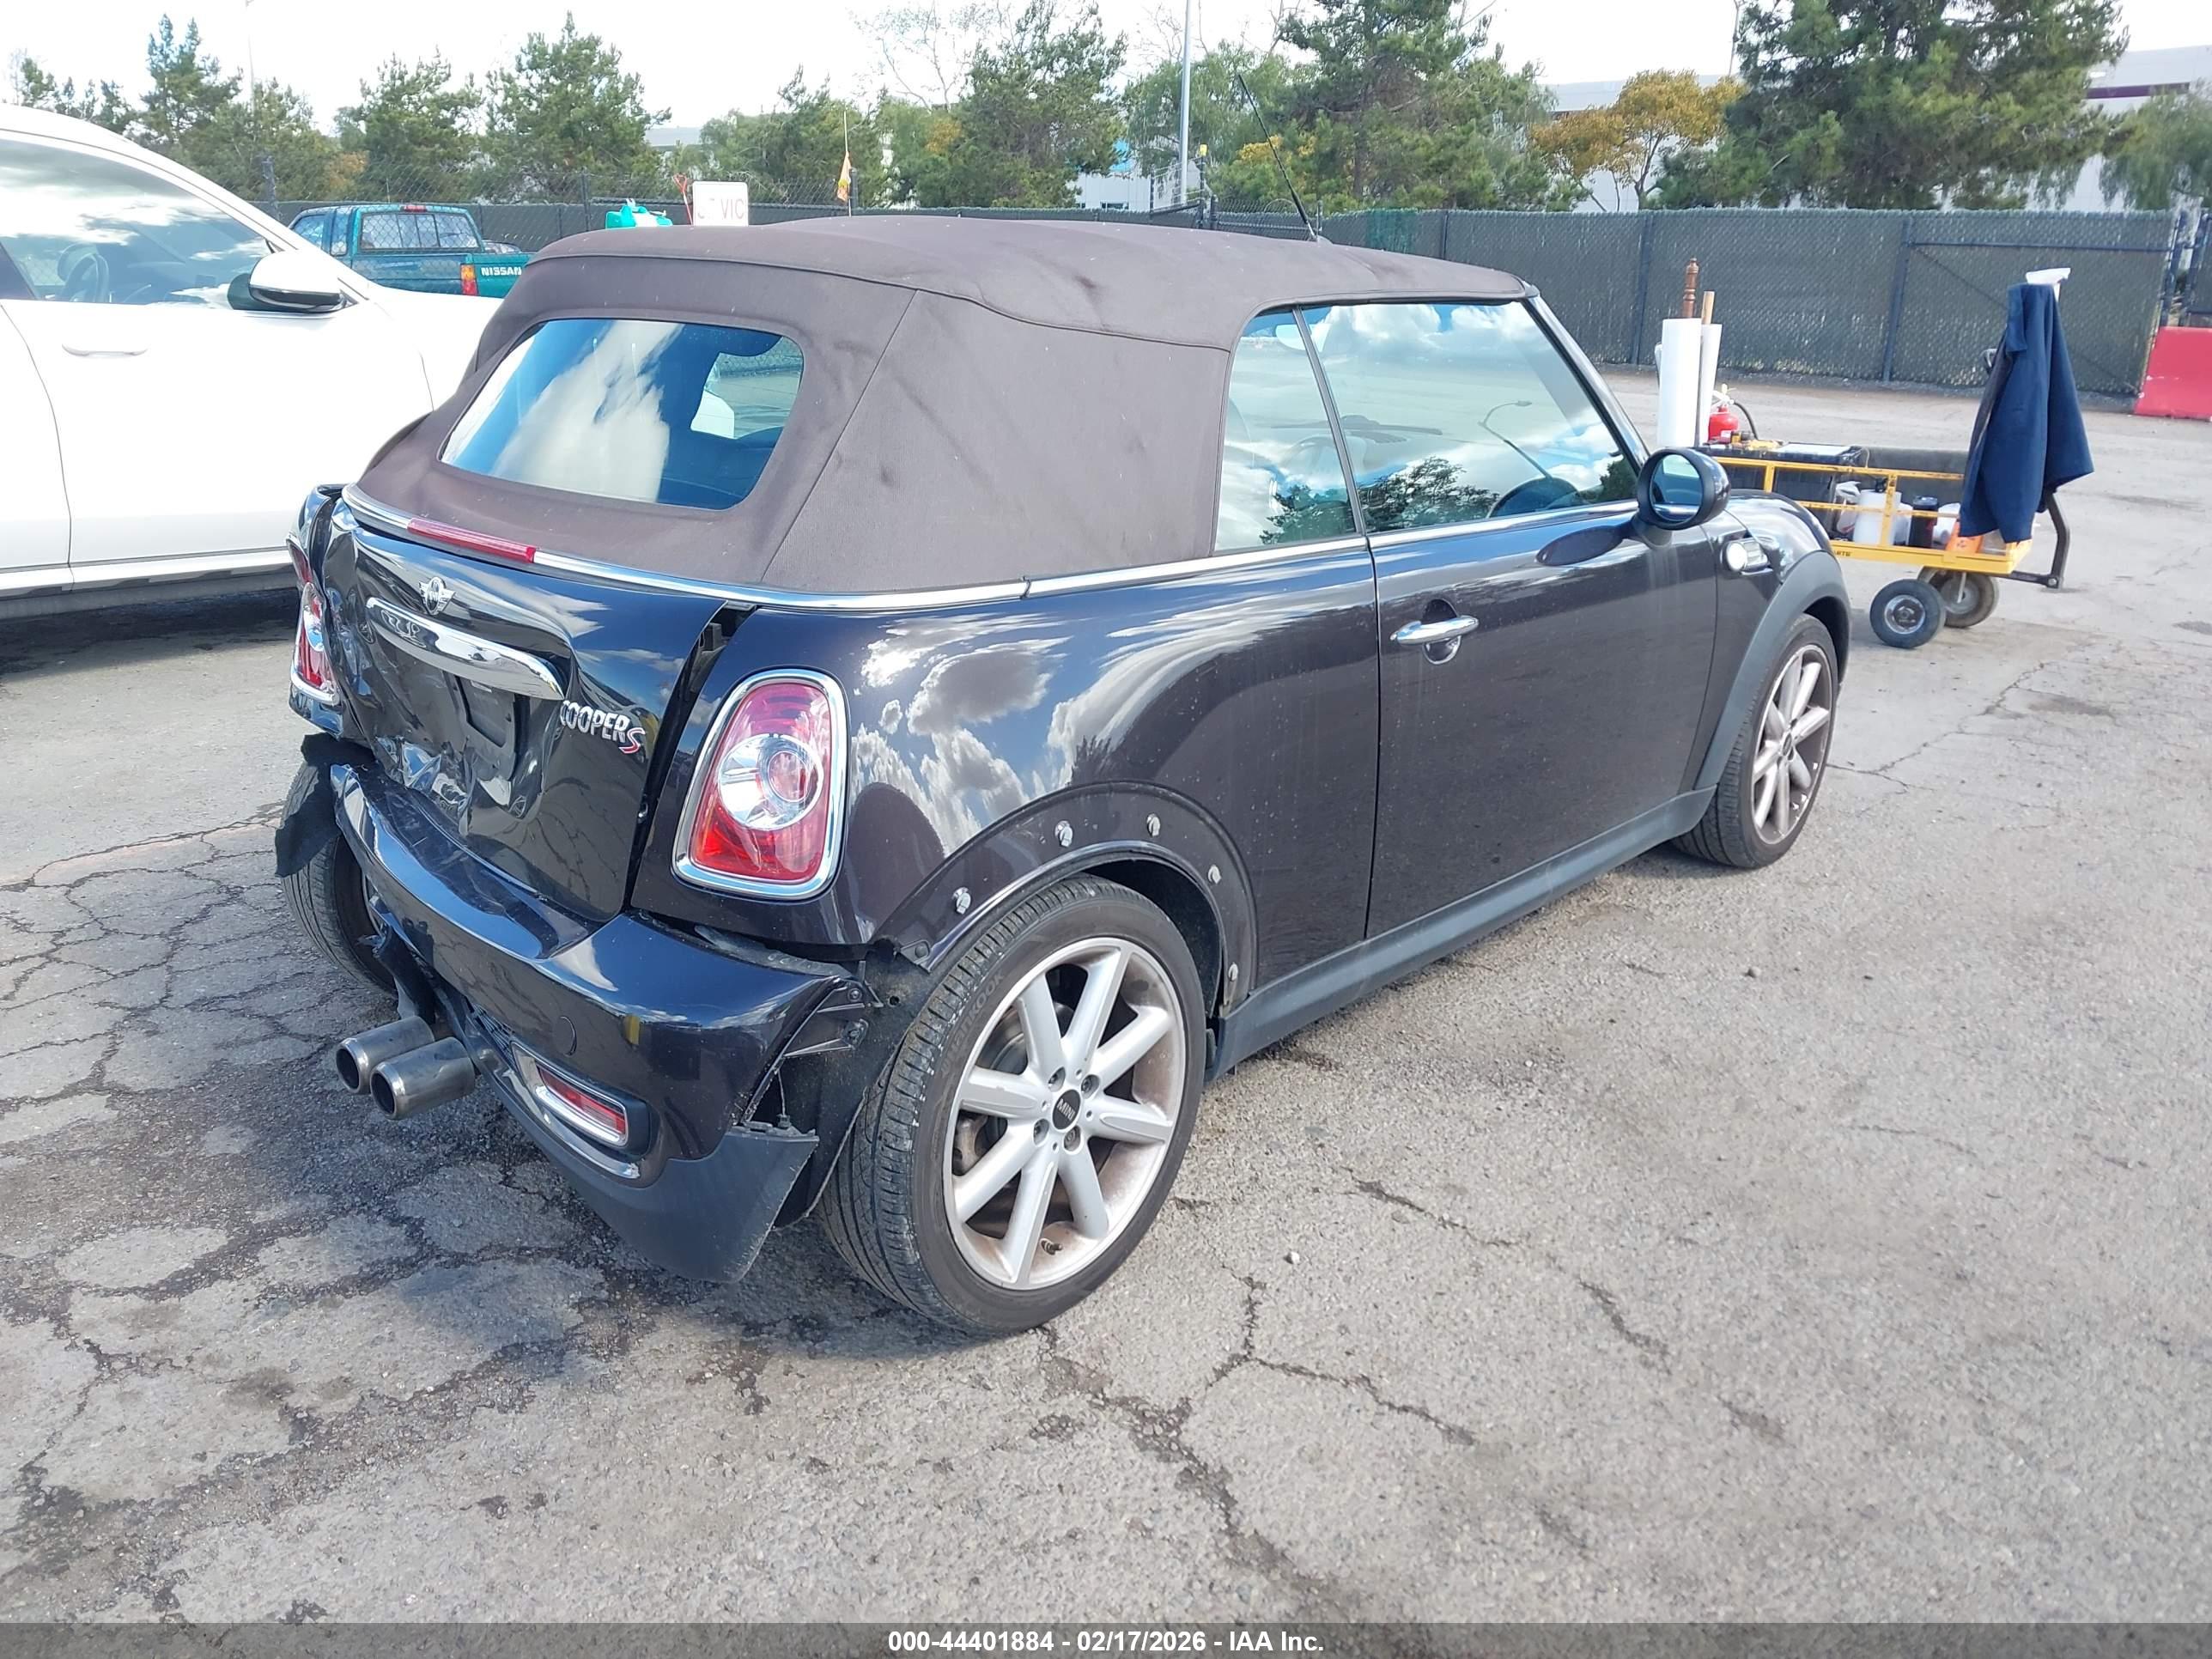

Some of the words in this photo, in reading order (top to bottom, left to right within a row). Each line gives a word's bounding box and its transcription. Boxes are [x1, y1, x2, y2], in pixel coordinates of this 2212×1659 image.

[481, 266, 522, 276] NISSAN
[560, 700, 631, 743] COOPER
[1056, 1098, 1076, 1121] MINI
